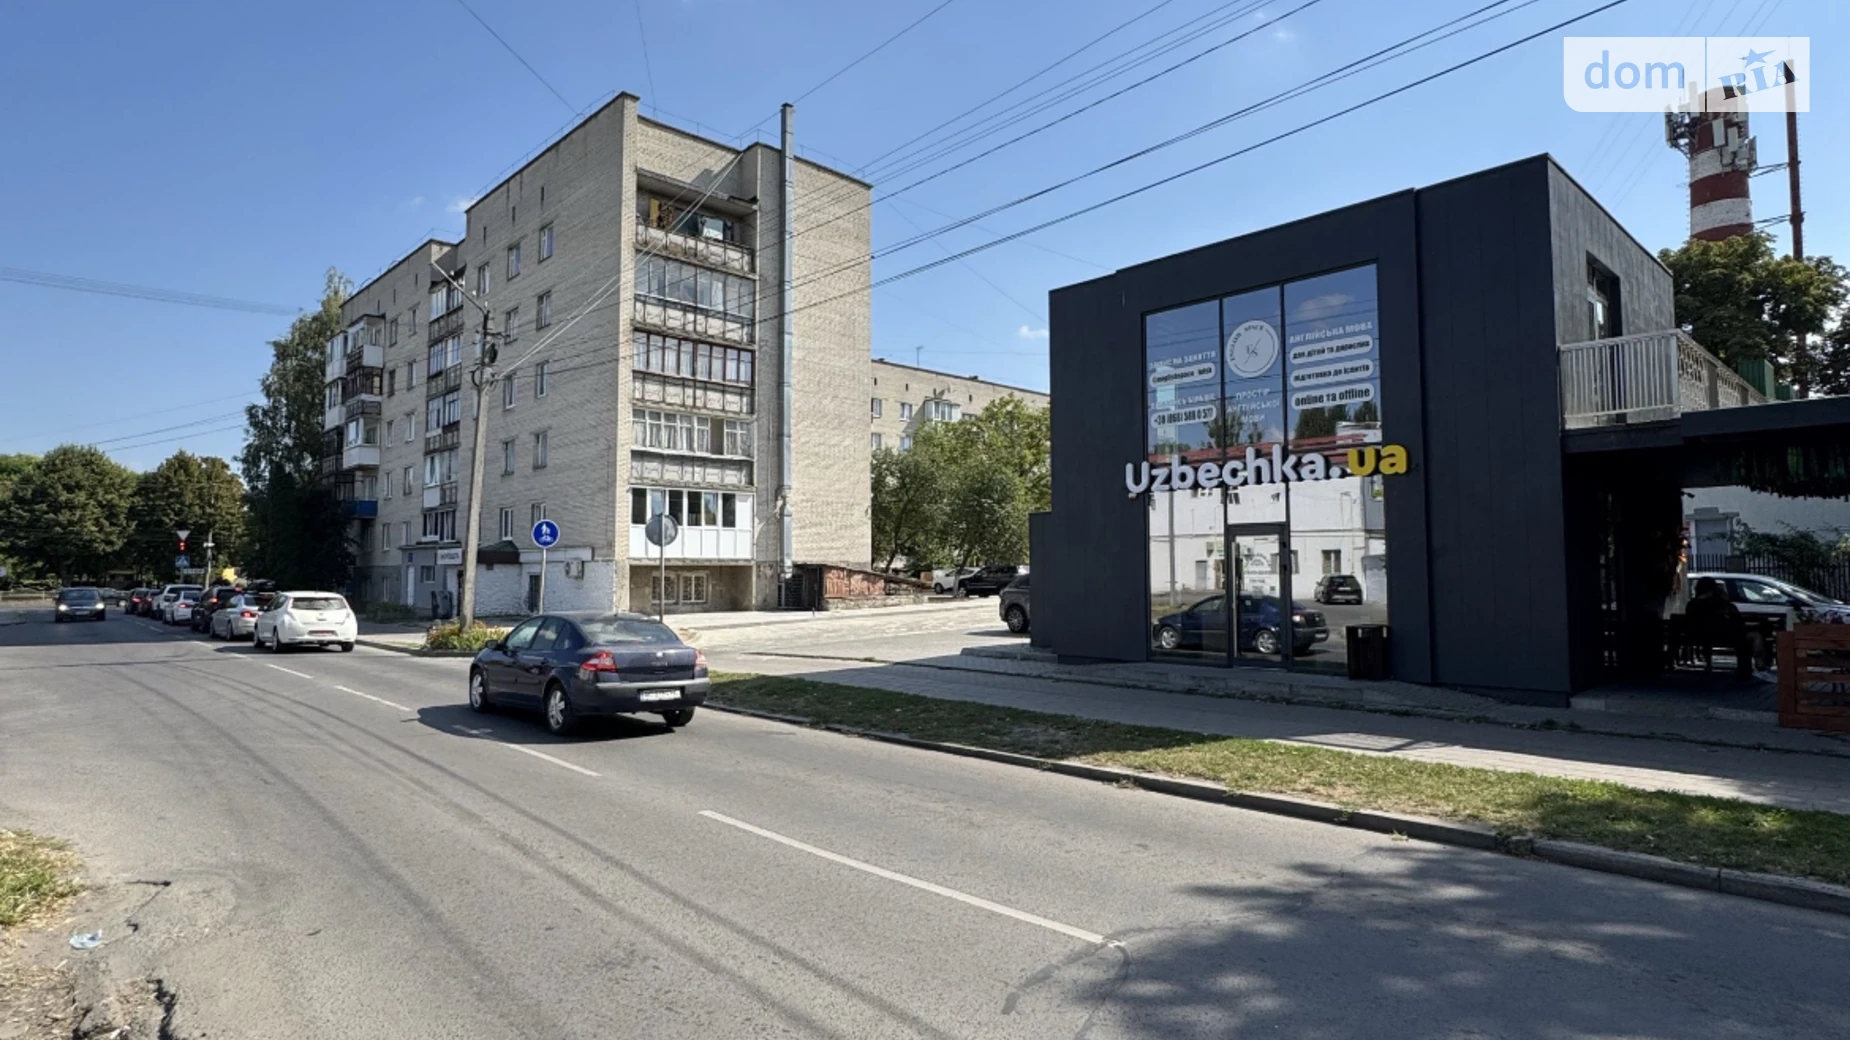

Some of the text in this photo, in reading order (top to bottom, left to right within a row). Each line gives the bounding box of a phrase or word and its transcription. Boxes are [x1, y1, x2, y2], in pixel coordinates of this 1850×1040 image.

[1290, 328, 1344, 343] АНГЛІЙСЬКА
[1294, 394, 1324, 407] online
[1338, 387, 1370, 401] offline
[1125, 443, 1408, 494] Uzbechka.ua
